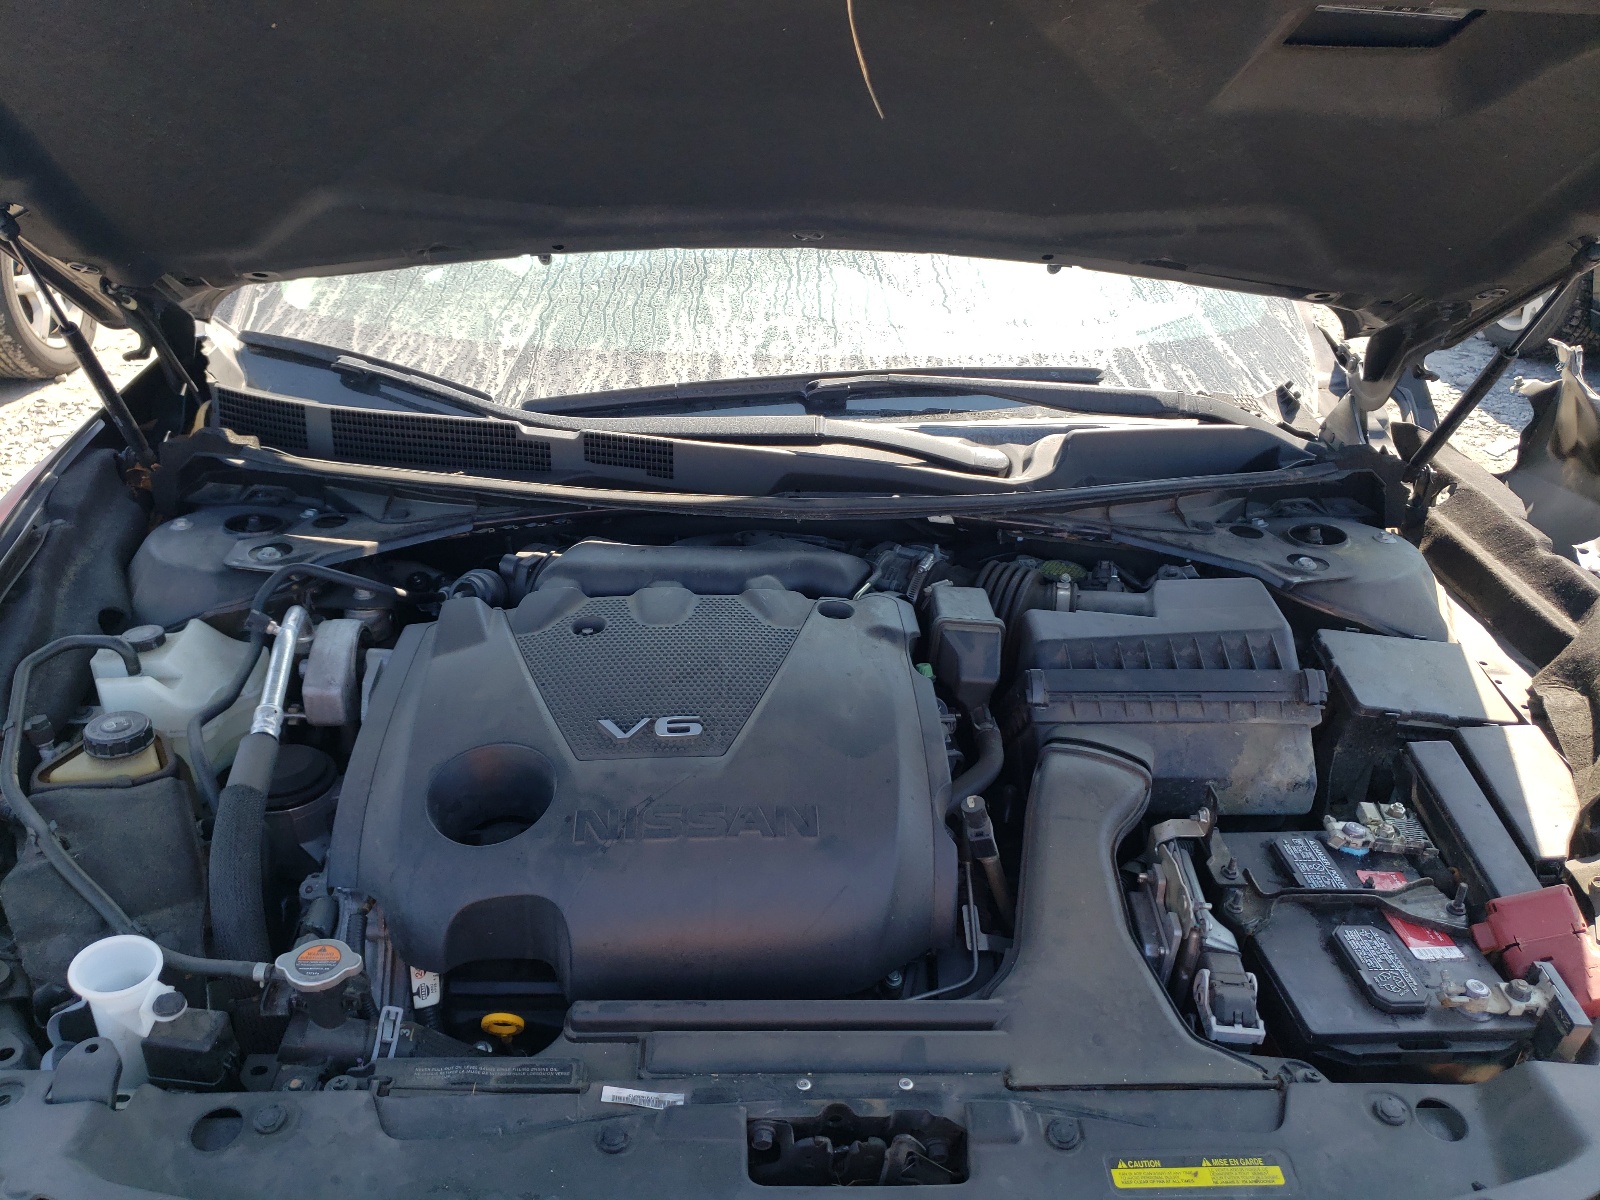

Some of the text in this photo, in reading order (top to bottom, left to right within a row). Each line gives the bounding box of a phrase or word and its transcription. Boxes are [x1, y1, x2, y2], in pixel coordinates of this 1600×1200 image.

[598, 715, 703, 742] V6
[572, 804, 820, 843] NISSAN
[1127, 1157, 1264, 1168] CAUTION MISE EN GARDE
